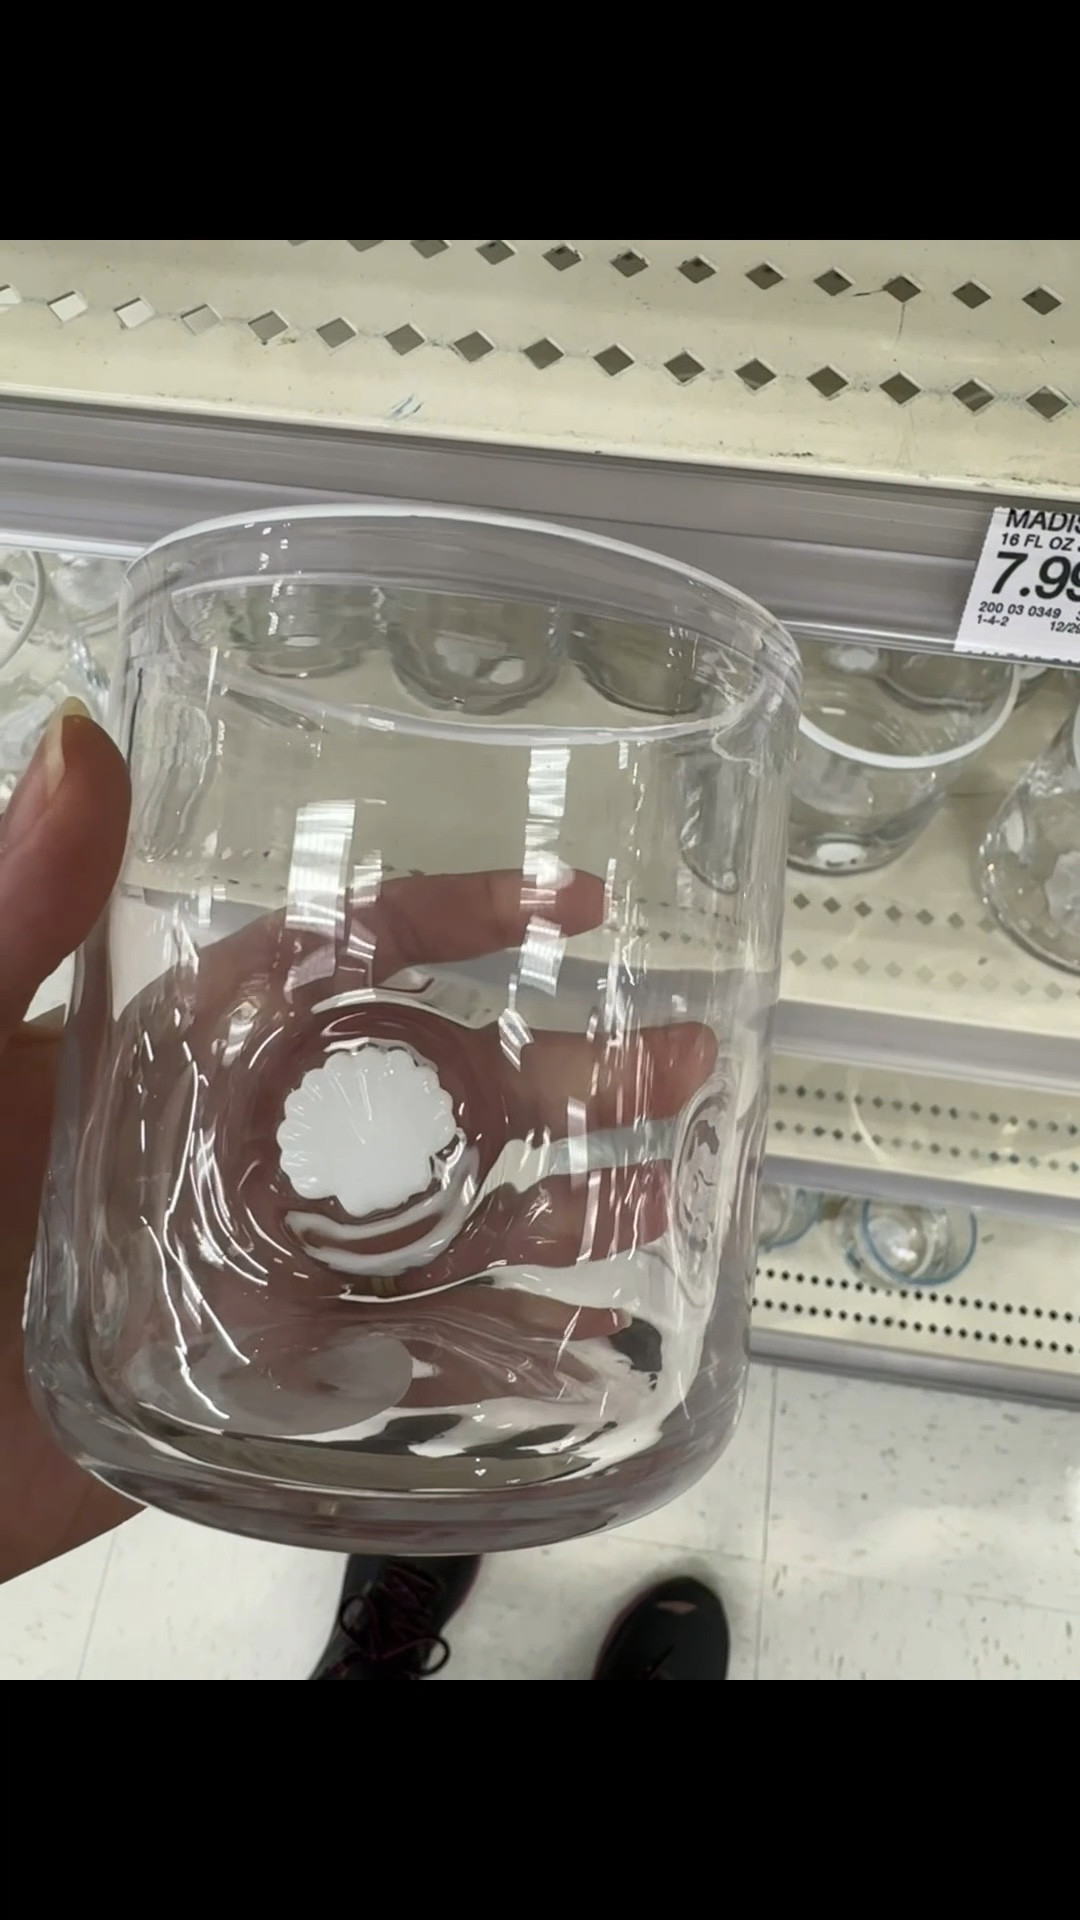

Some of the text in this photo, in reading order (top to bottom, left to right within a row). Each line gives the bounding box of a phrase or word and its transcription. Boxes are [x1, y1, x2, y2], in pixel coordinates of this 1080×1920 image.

[1002, 532, 1020, 546] 16
[1024, 534, 1043, 548] FL
[1049, 536, 1075, 551] OZ
[979, 601, 1004, 613] 200
[1007, 604, 1025, 615] 03
[1028, 606, 1062, 619] 0349
[977, 615, 1009, 626] 1-4-2
